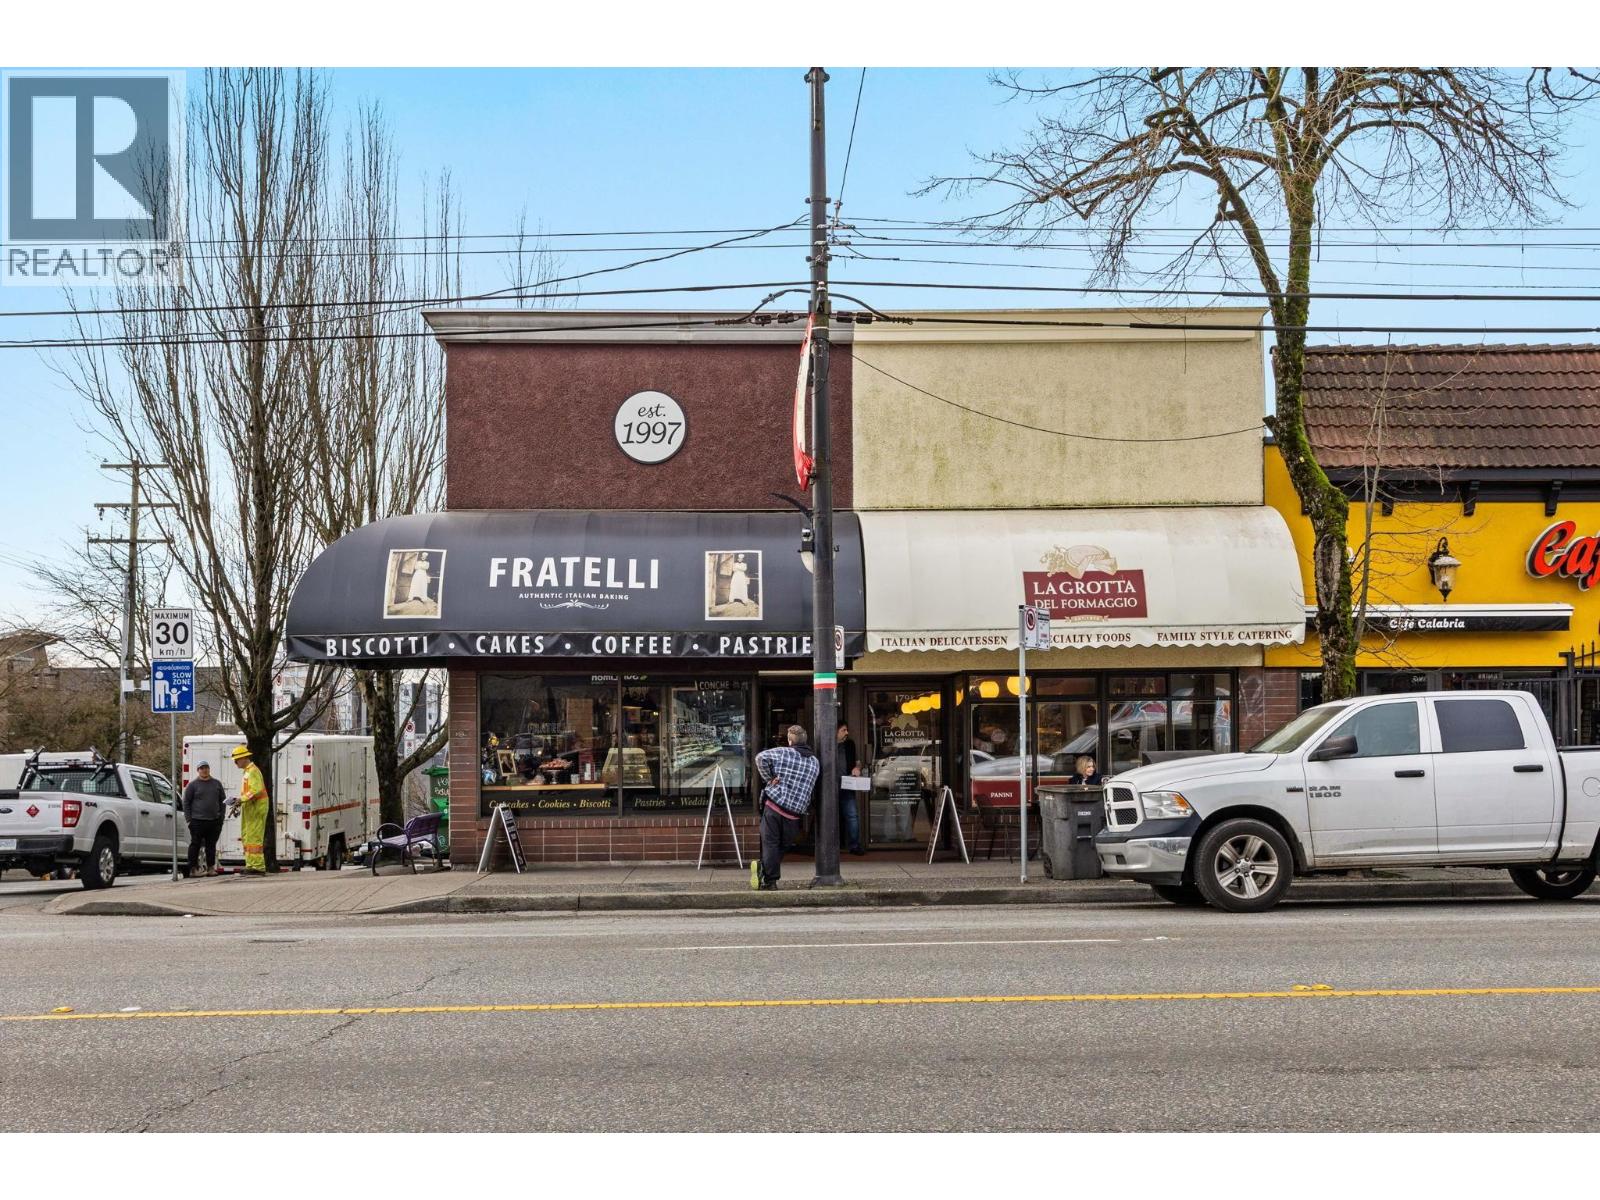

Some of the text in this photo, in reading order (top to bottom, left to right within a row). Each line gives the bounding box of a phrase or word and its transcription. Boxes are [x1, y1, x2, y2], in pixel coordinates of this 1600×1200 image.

[637, 403, 666, 418] est.
[621, 421, 682, 445] 1997
[489, 556, 659, 589] FRATELLI
[1059, 580, 1136, 595] GROTTA
[1034, 597, 1138, 609] DEL FORMAGGIO
[155, 612, 189, 620] MAXIMUM
[1417, 618, 1466, 629] Calabria
[155, 621, 189, 645] 30
[1096, 632, 1131, 643] FOODS
[1157, 629, 1293, 641] FAMILY STYLE CATERING
[326, 635, 811, 657] BISCOTTI CAKES COFFEE PASTRIE
[881, 635, 1009, 647] ITALIAN DELICATESSEN
[159, 648, 186, 656] km/h
[538, 800, 570, 808] Cookies
[579, 800, 611, 808] Biscotti
[634, 798, 666, 807] Pastries
